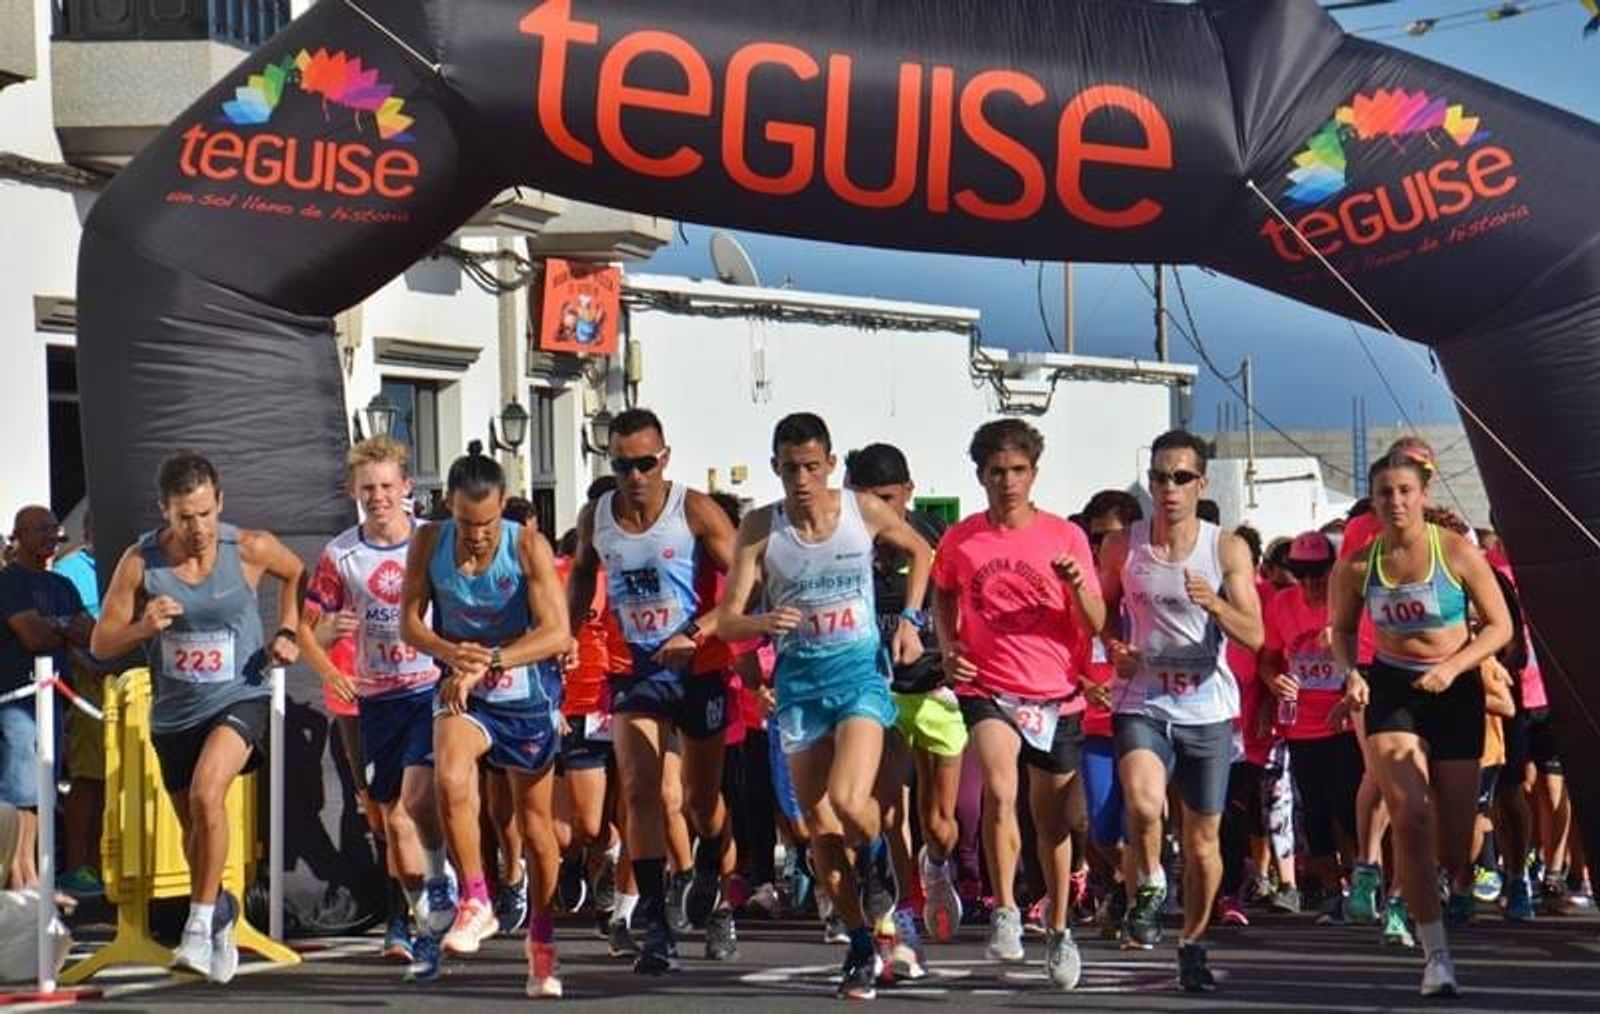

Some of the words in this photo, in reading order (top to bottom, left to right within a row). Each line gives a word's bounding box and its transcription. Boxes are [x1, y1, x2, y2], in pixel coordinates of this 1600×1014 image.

[242, 194, 294, 215] lleno
[300, 204, 321, 220] de
[630, 608, 670, 633] 127
[808, 608, 856, 636] 174
[1381, 600, 1426, 625] 109
[174, 649, 223, 673] 223
